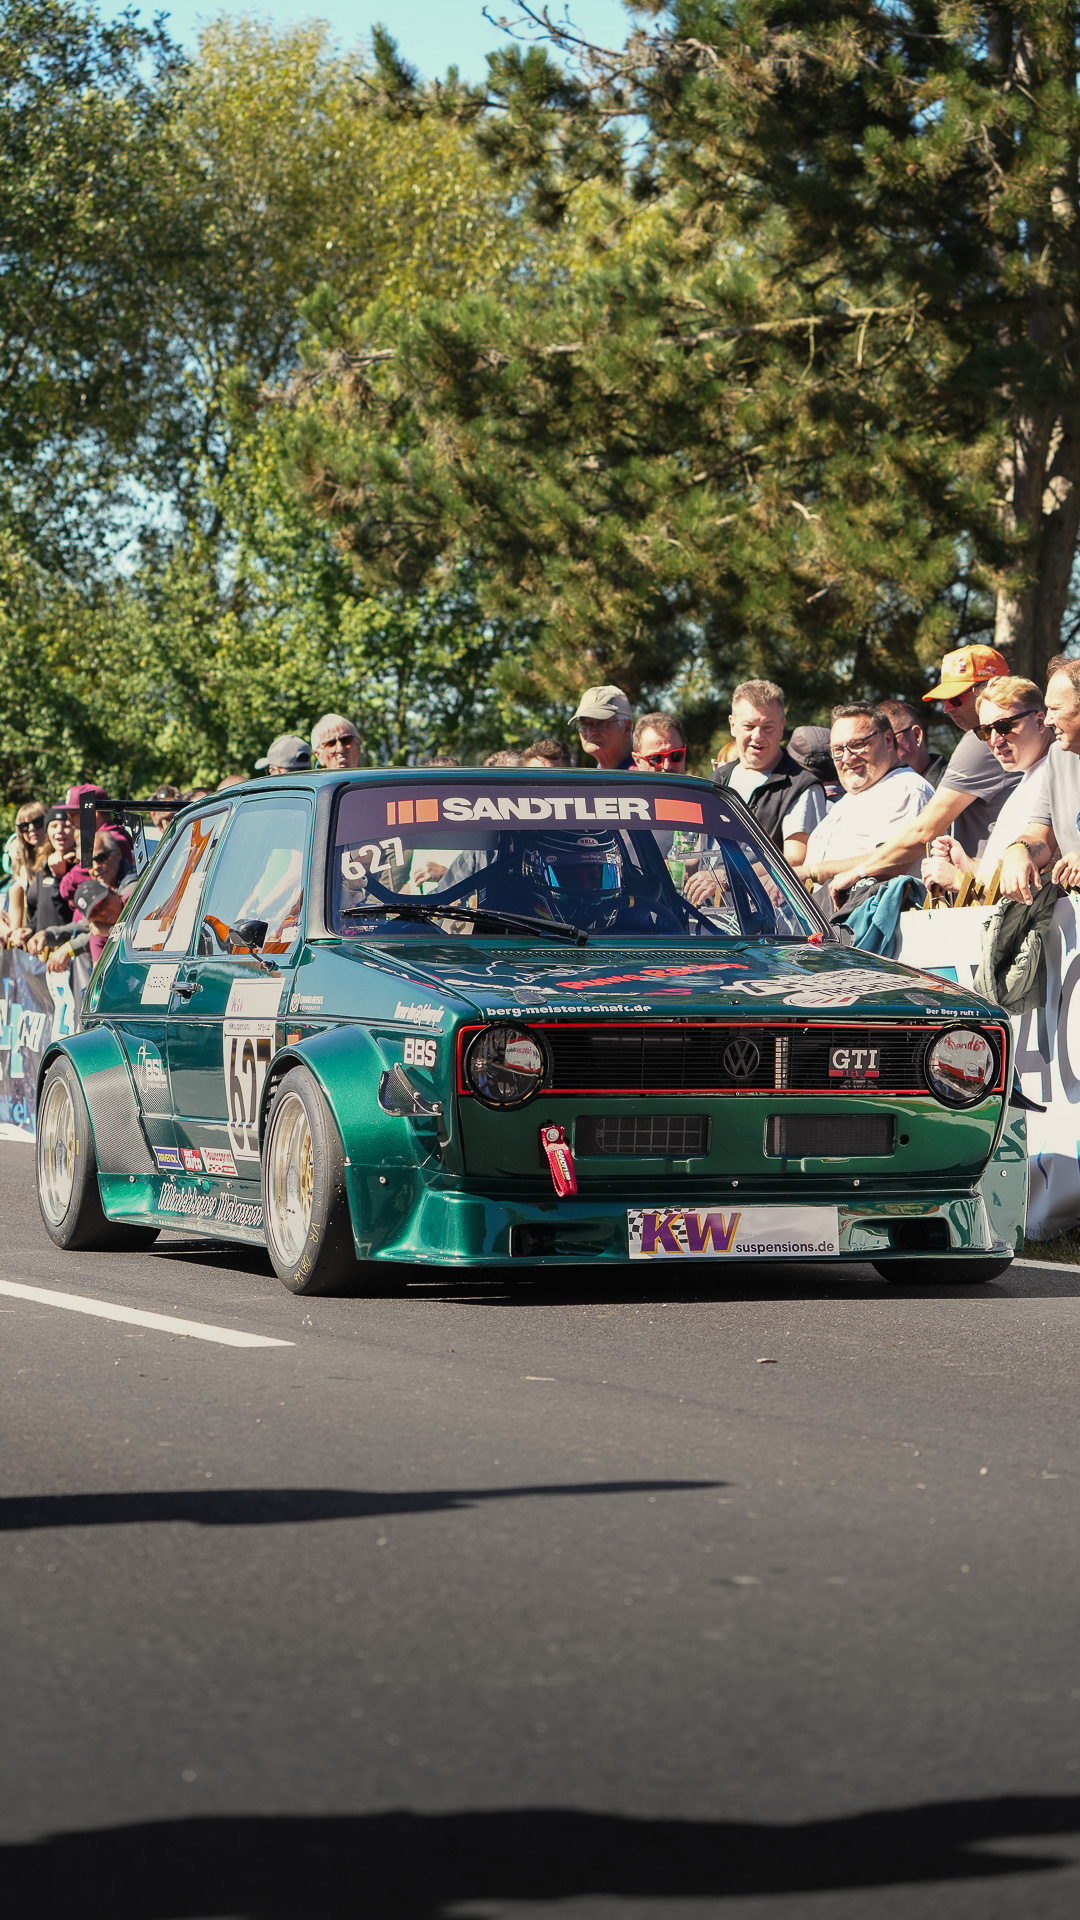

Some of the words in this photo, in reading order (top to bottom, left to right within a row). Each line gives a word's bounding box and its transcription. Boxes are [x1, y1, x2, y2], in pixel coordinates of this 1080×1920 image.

[442, 797, 651, 822] SANDTLER
[341, 836, 405, 880] 627
[486, 1005, 652, 1017] berg-meisterschaft.de
[925, 1007, 939, 1015] Der
[940, 1008, 959, 1018] Berg
[404, 1038, 437, 1067] BBS
[832, 1049, 878, 1069] GTI
[640, 1212, 742, 1254] KW
[735, 1241, 835, 1255] suspensions.de
